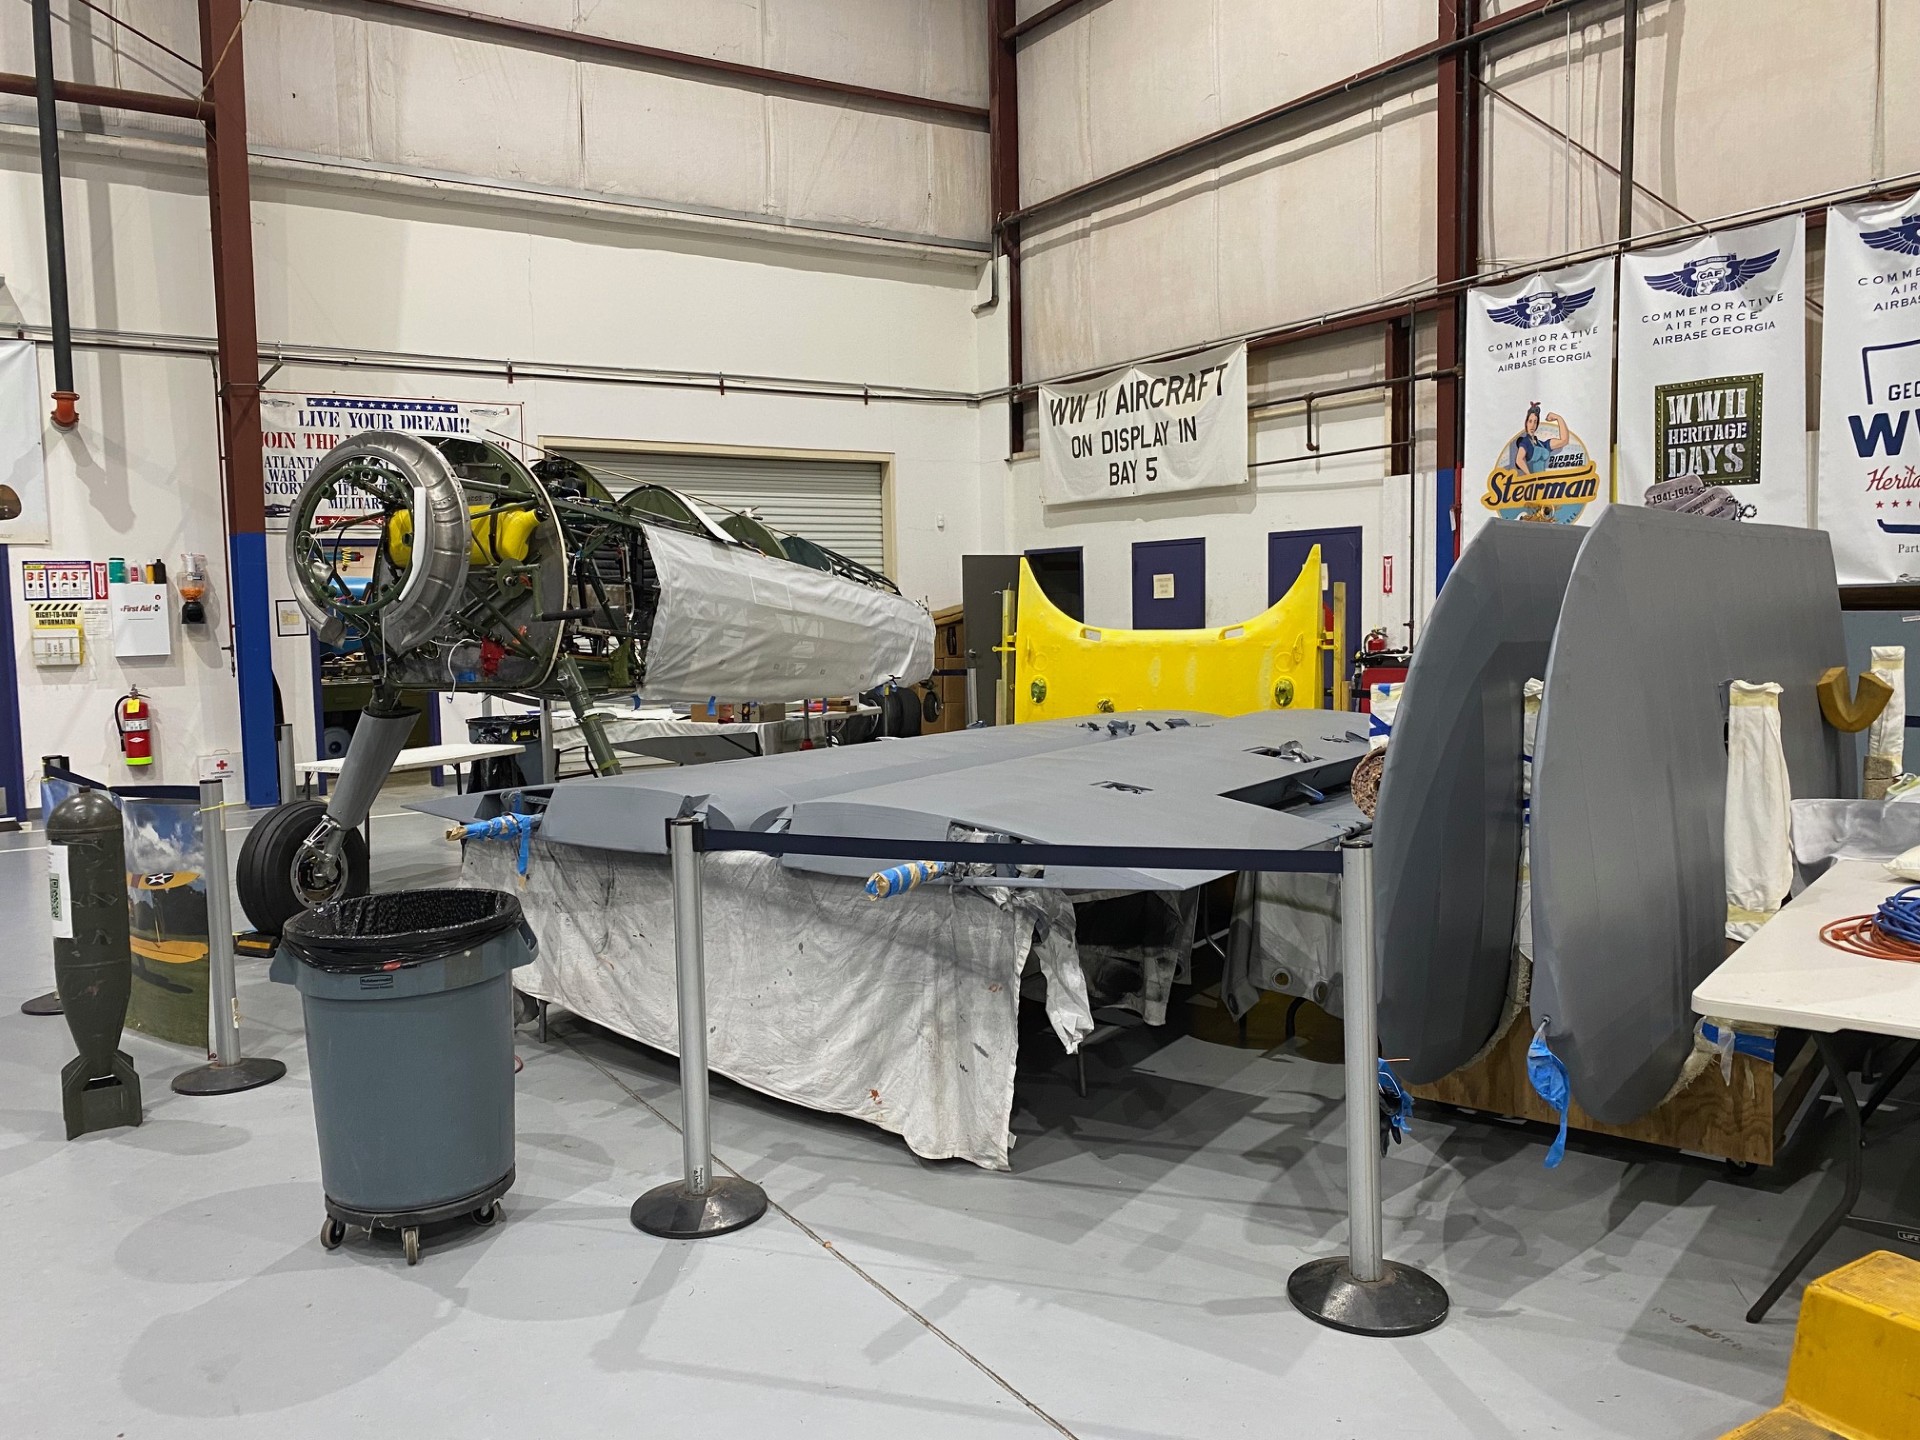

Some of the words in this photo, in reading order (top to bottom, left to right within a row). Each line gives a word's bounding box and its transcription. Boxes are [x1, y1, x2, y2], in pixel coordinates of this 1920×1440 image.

[1700, 270, 1722, 280] CAF
[1891, 282, 1918, 295] AIR
[1641, 293, 1784, 323] COMMEMORATIVE
[1652, 329, 1708, 346] AIRBASE
[1711, 320, 1776, 337] GEORGIA
[1665, 320, 1692, 331] AIR
[1487, 326, 1598, 353] COMMEMORATIVE
[1497, 358, 1537, 373] AIRBASE
[1539, 351, 1592, 364] GEORGIA
[1508, 350, 1528, 360] AIR
[1050, 393, 1090, 427] WW
[1095, 389, 1108, 420] II
[1115, 362, 1229, 415] AIRCRAFT
[1666, 388, 1748, 425] WWII
[298, 410, 340, 427] LIVE
[348, 412, 394, 430] YOUR
[401, 414, 470, 433] DREAM!!
[303, 433, 340, 450] THE
[1071, 433, 1093, 459] ON
[1101, 420, 1169, 455] DISPLAY
[1178, 416, 1197, 443] IN
[1667, 422, 1748, 446] HERITAGE
[1848, 408, 1920, 458] W
[1548, 459, 1584, 469] GEORGIA
[1549, 453, 1584, 462] AIRBASE
[1667, 443, 1746, 478] DAYS
[268, 470, 297, 482] WAR
[1109, 459, 1138, 486] BAY
[1146, 457, 1158, 482] 5
[1484, 466, 1596, 506] Stearman
[1652, 485, 1695, 504] 1941-1945
[1898, 543, 1920, 553] Part
[26, 571, 44, 581] BE
[50, 571, 89, 581] FAST
[35, 611, 78, 619] RIGHT-TO-KNOW
[123, 604, 139, 612] First
[140, 604, 151, 612] Aid
